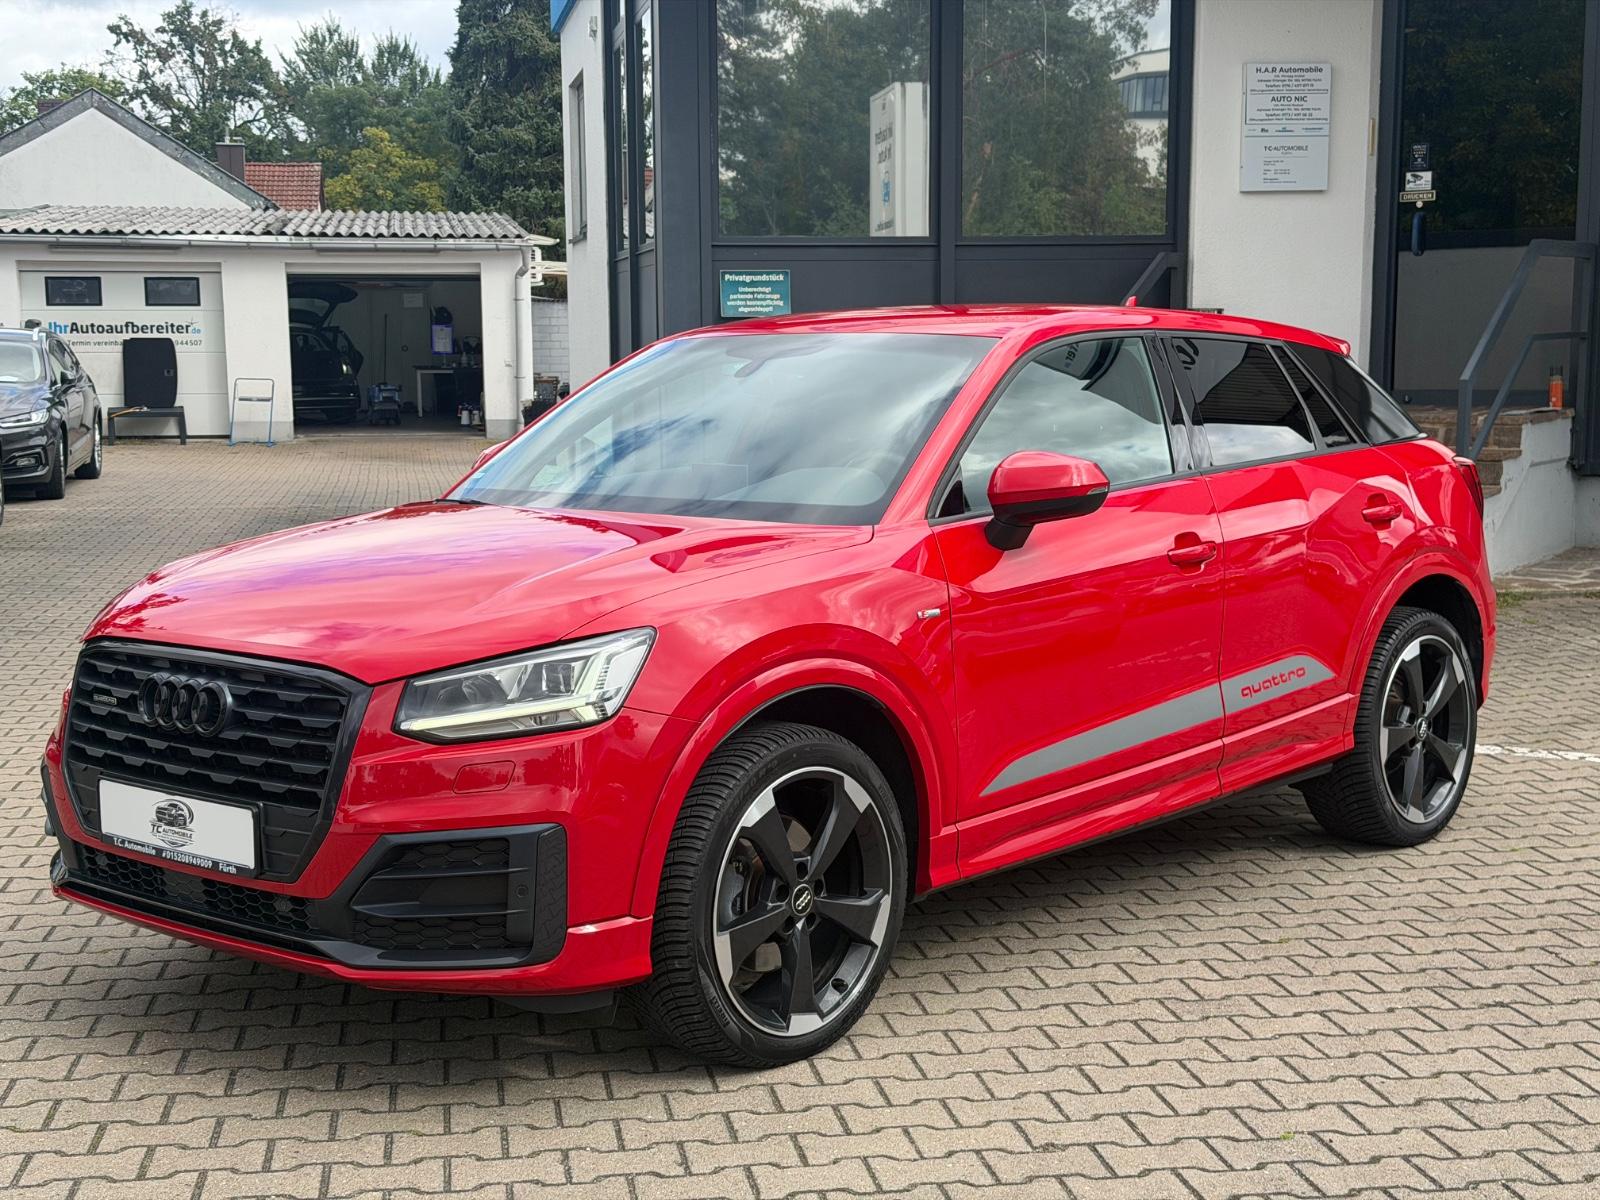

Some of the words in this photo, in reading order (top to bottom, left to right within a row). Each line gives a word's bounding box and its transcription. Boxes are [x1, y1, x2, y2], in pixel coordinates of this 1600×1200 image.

[725, 274, 784, 282] Privatgrundstück
[1241, 667, 1306, 698] quattro
[124, 840, 156, 855] Automobile
[219, 862, 237, 874] Fürth
